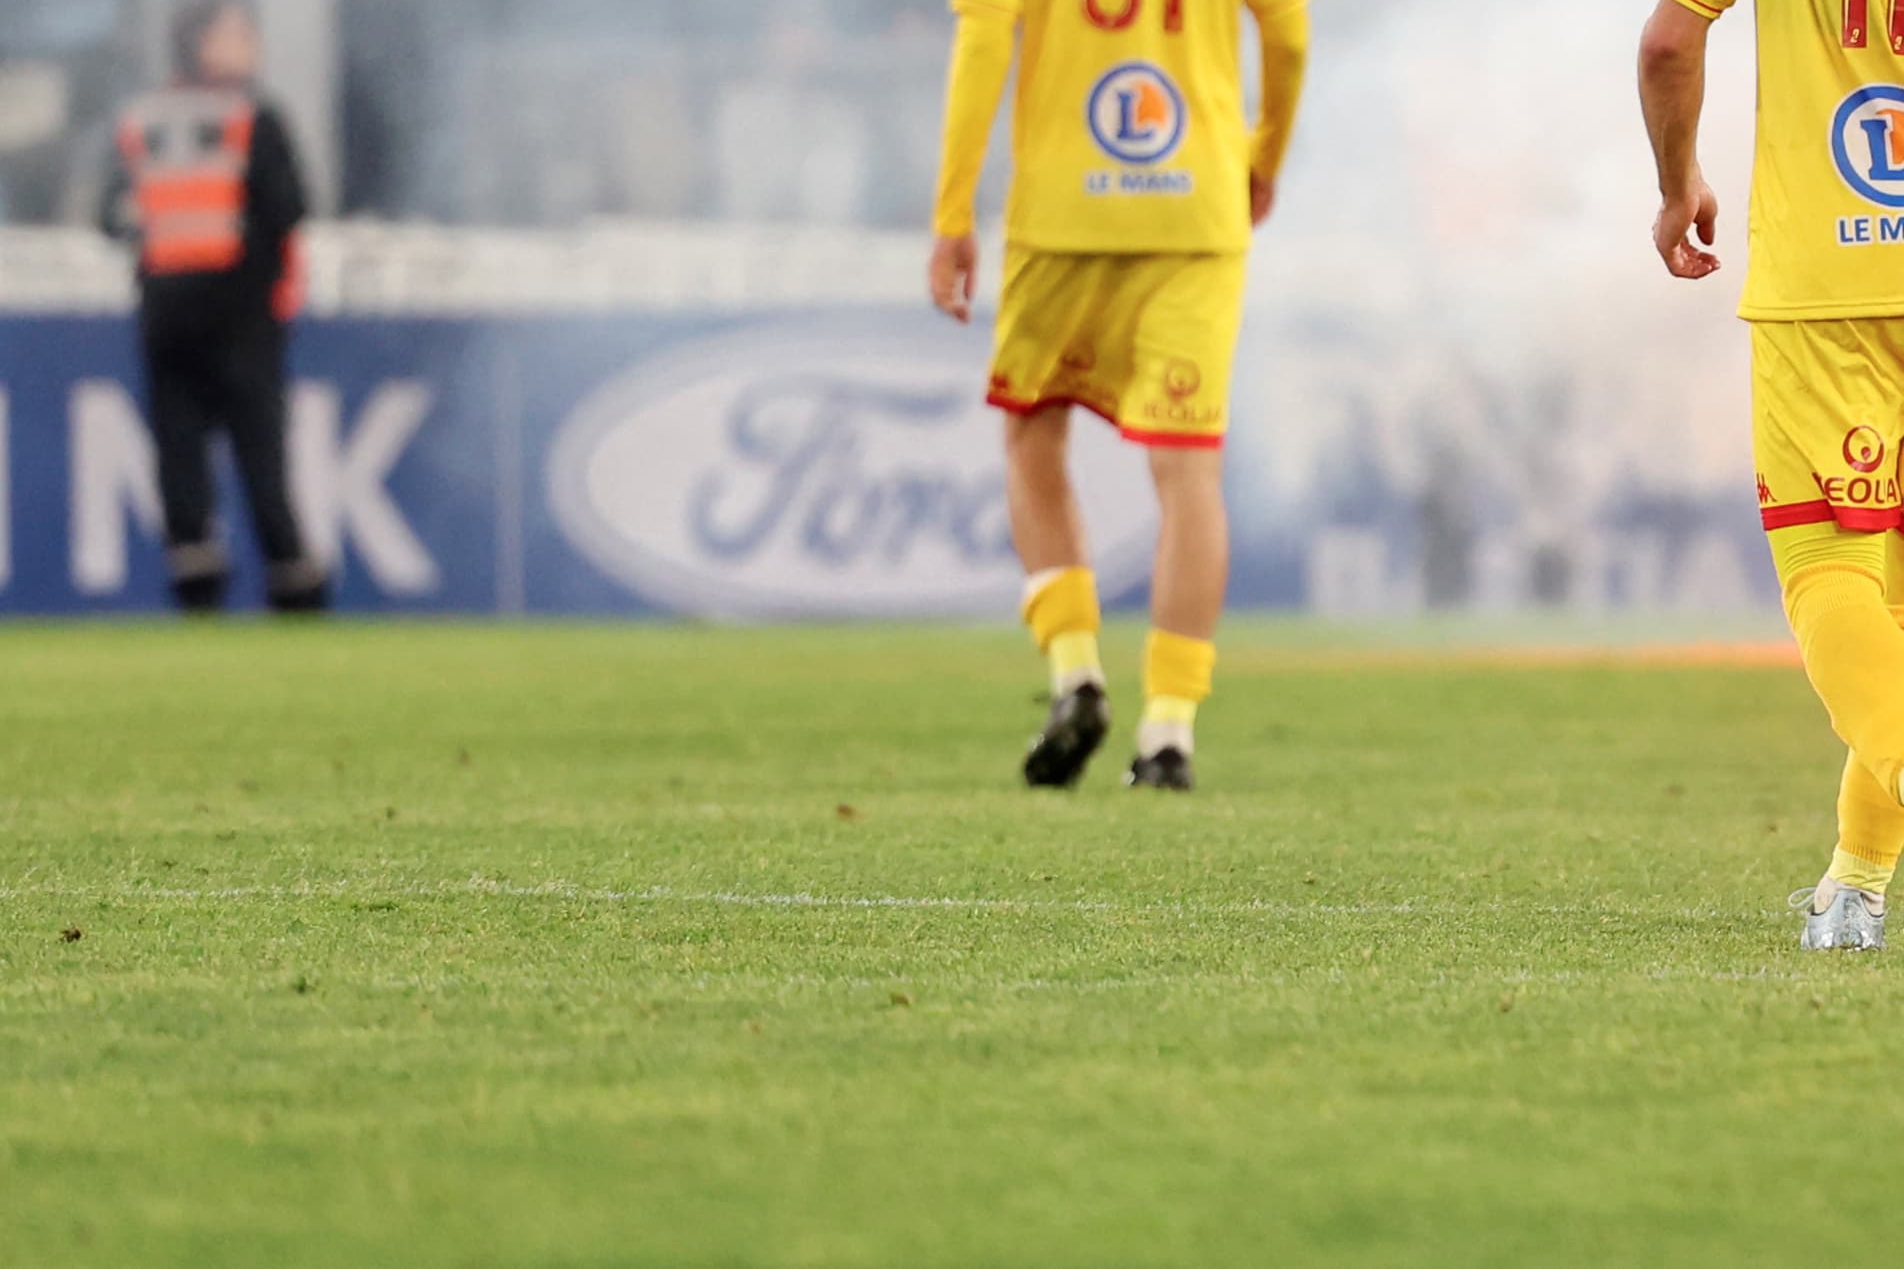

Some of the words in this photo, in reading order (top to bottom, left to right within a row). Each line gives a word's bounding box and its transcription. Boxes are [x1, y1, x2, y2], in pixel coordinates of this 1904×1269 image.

[1087, 173, 1109, 191] LE
[1839, 218, 1871, 243] LE
[0, 380, 440, 594] NK
